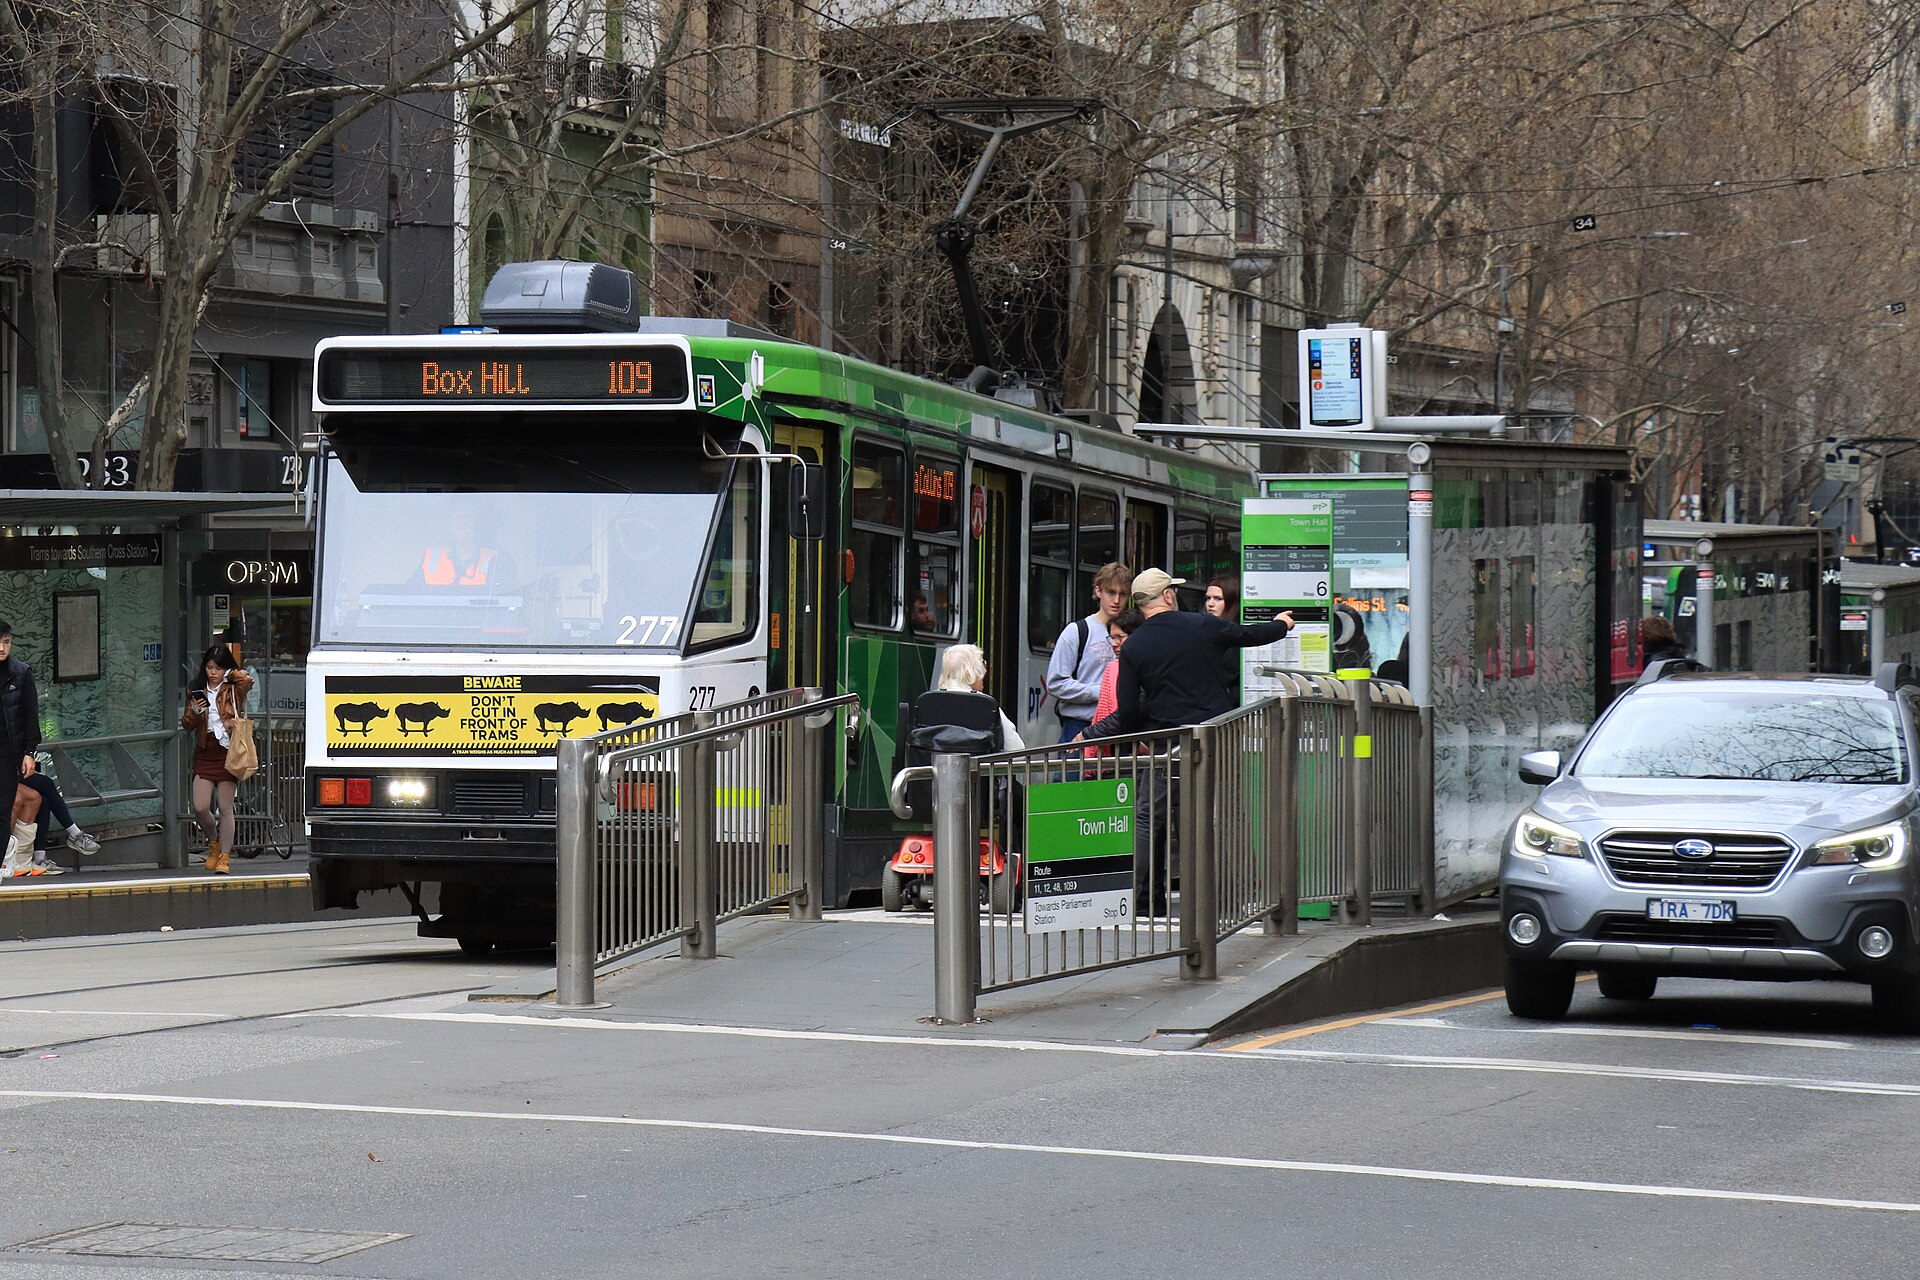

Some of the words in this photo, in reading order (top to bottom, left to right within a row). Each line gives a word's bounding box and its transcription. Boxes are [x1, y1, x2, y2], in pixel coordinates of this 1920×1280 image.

[1575, 218, 1594, 229] 34
[830, 239, 846, 249] 34
[422, 361, 473, 394] Box
[481, 361, 530, 394] Hill
[608, 361, 652, 394] 109
[1289, 518, 1311, 526] Town
[1312, 518, 1328, 526] Hall
[30, 545, 50, 561] Trams
[51, 545, 77, 561] towards
[78, 545, 106, 560] Southern
[108, 544, 125, 559] Cross
[127, 543, 148, 558] Station
[227, 560, 299, 584] OPSM
[1317, 581, 1328, 596] 6
[1371, 597, 1387, 612] St
[616, 615, 679, 645] 277
[463, 676, 522, 689] BEWARE
[471, 696, 515, 707] DON'T
[689, 686, 716, 711] 277
[471, 707, 499, 718] CUT
[503, 707, 516, 718] IN
[461, 719, 506, 729] FRONT
[509, 719, 528, 729] OF
[470, 730, 519, 741] TRAMS
[1078, 818, 1105, 835] Town
[1109, 816, 1128, 833] Hall
[1034, 866, 1052, 876] Route
[1034, 885, 1042, 894] 11,
[1053, 882, 1062, 893] 48,
[1063, 881, 1074, 891] 109
[1034, 900, 1061, 912] Towards
[1061, 898, 1093, 910] Parliament
[1119, 897, 1127, 917] 6
[1104, 906, 1118, 919] Stop
[1034, 915, 1056, 925] Station
